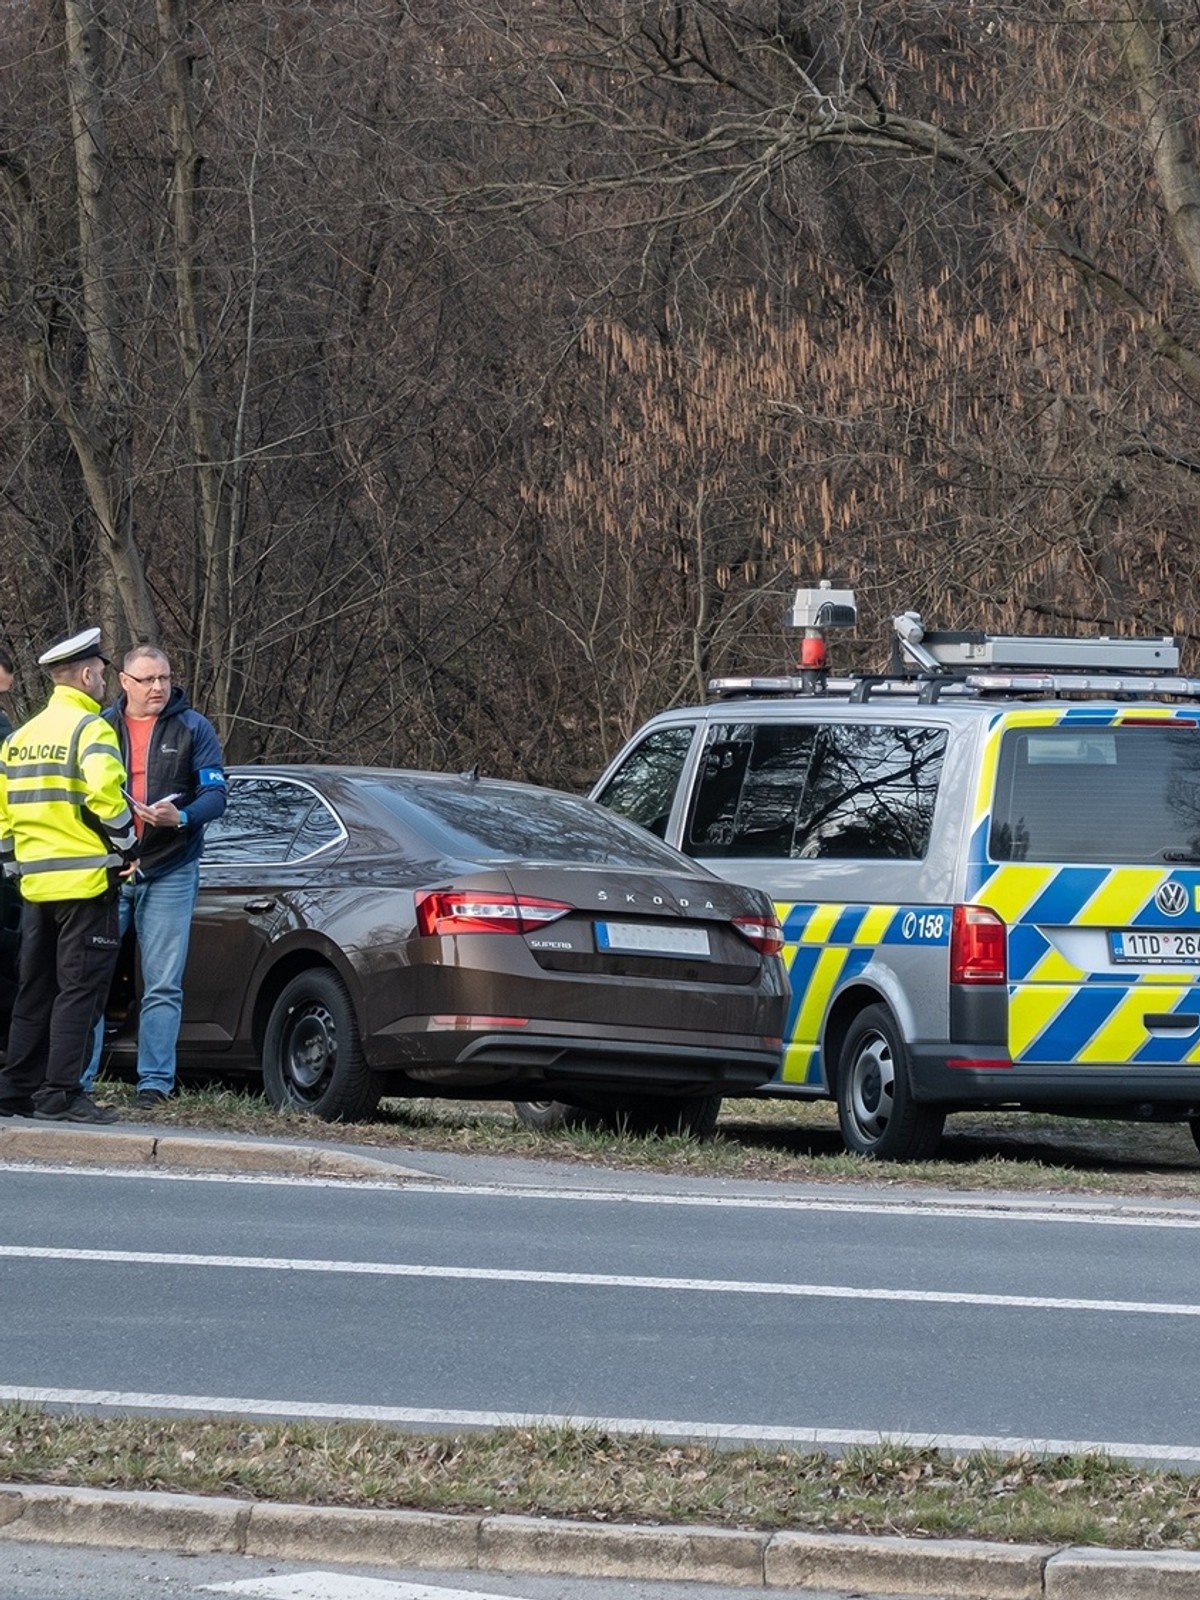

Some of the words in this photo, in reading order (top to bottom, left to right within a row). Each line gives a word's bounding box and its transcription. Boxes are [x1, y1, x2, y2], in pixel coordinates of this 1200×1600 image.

[8, 744, 68, 762] POLICIE
[918, 914, 944, 939] 158
[1128, 935, 1161, 955] 1TD
